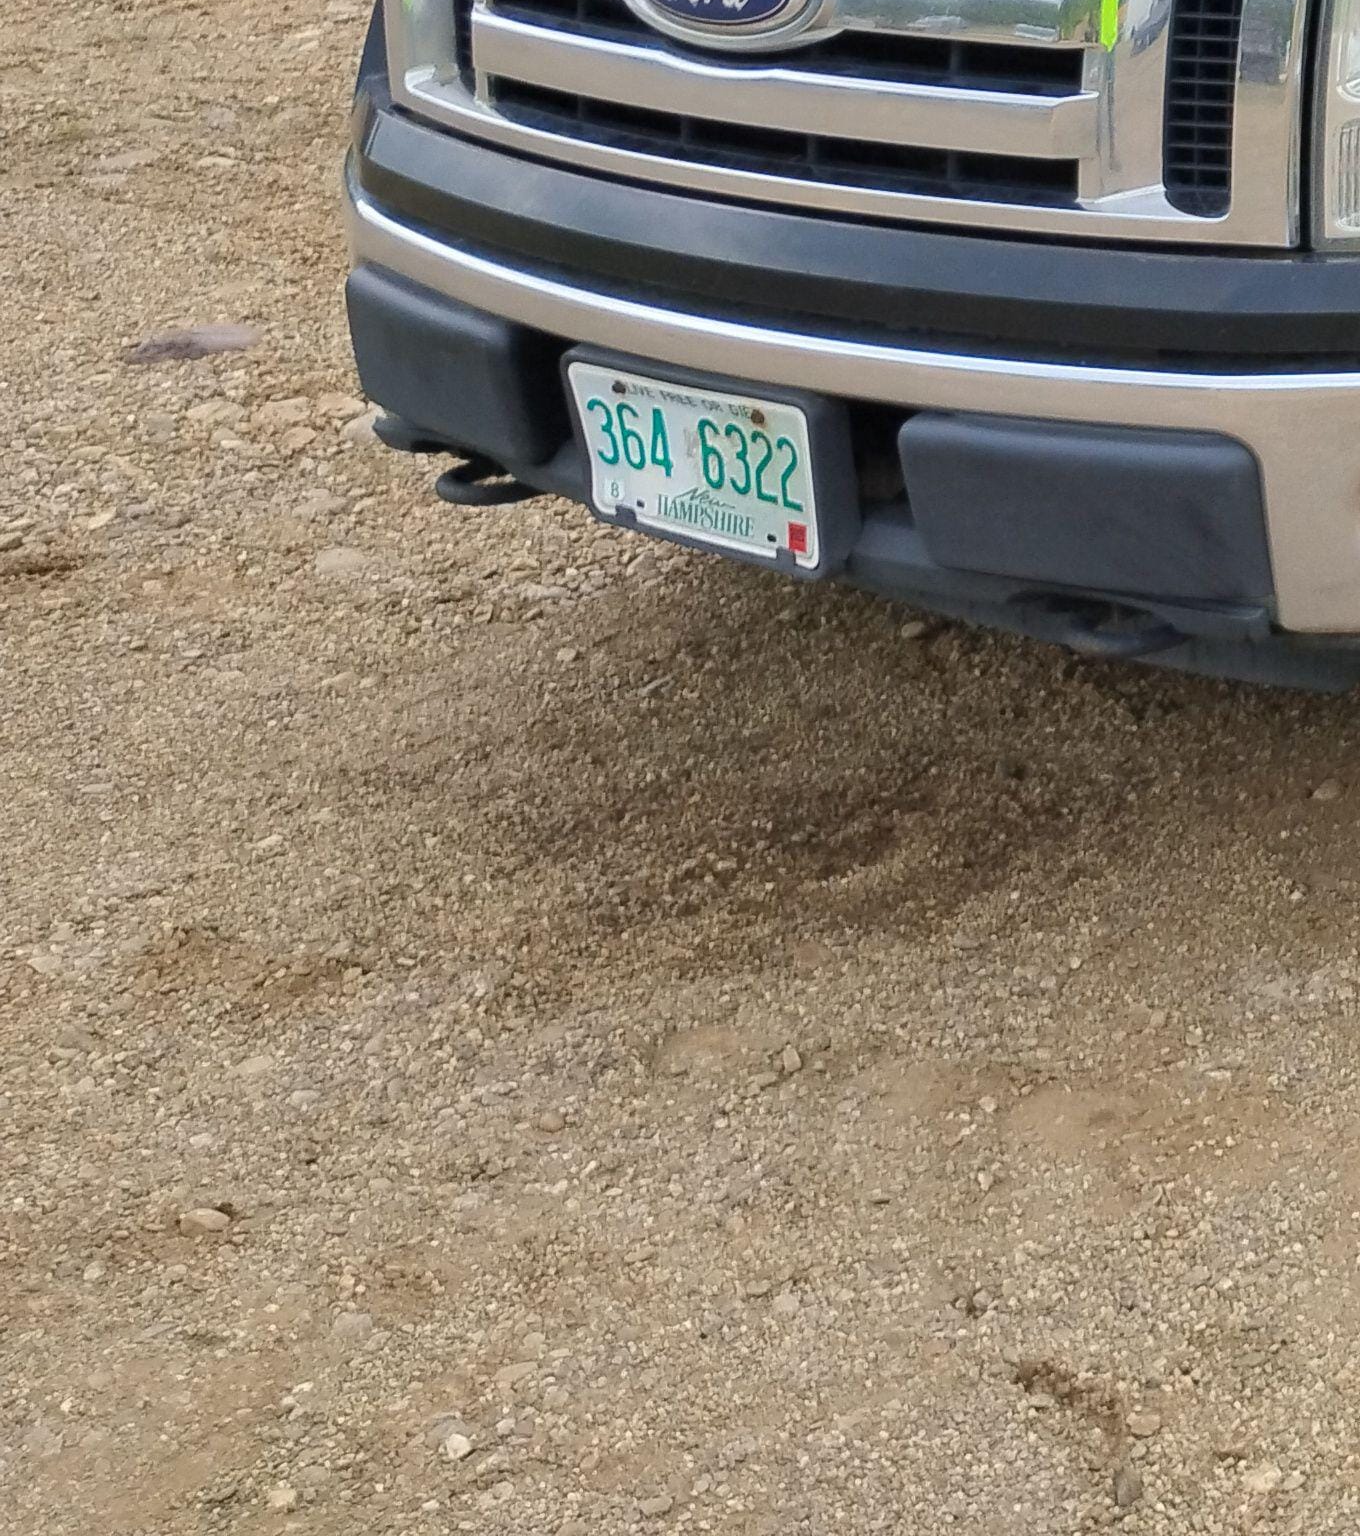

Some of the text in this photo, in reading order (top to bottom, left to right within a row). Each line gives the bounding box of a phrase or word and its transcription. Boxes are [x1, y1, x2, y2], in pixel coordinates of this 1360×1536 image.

[587, 398, 804, 513] 364 6322
[656, 492, 755, 537] HAMPSHIRE
